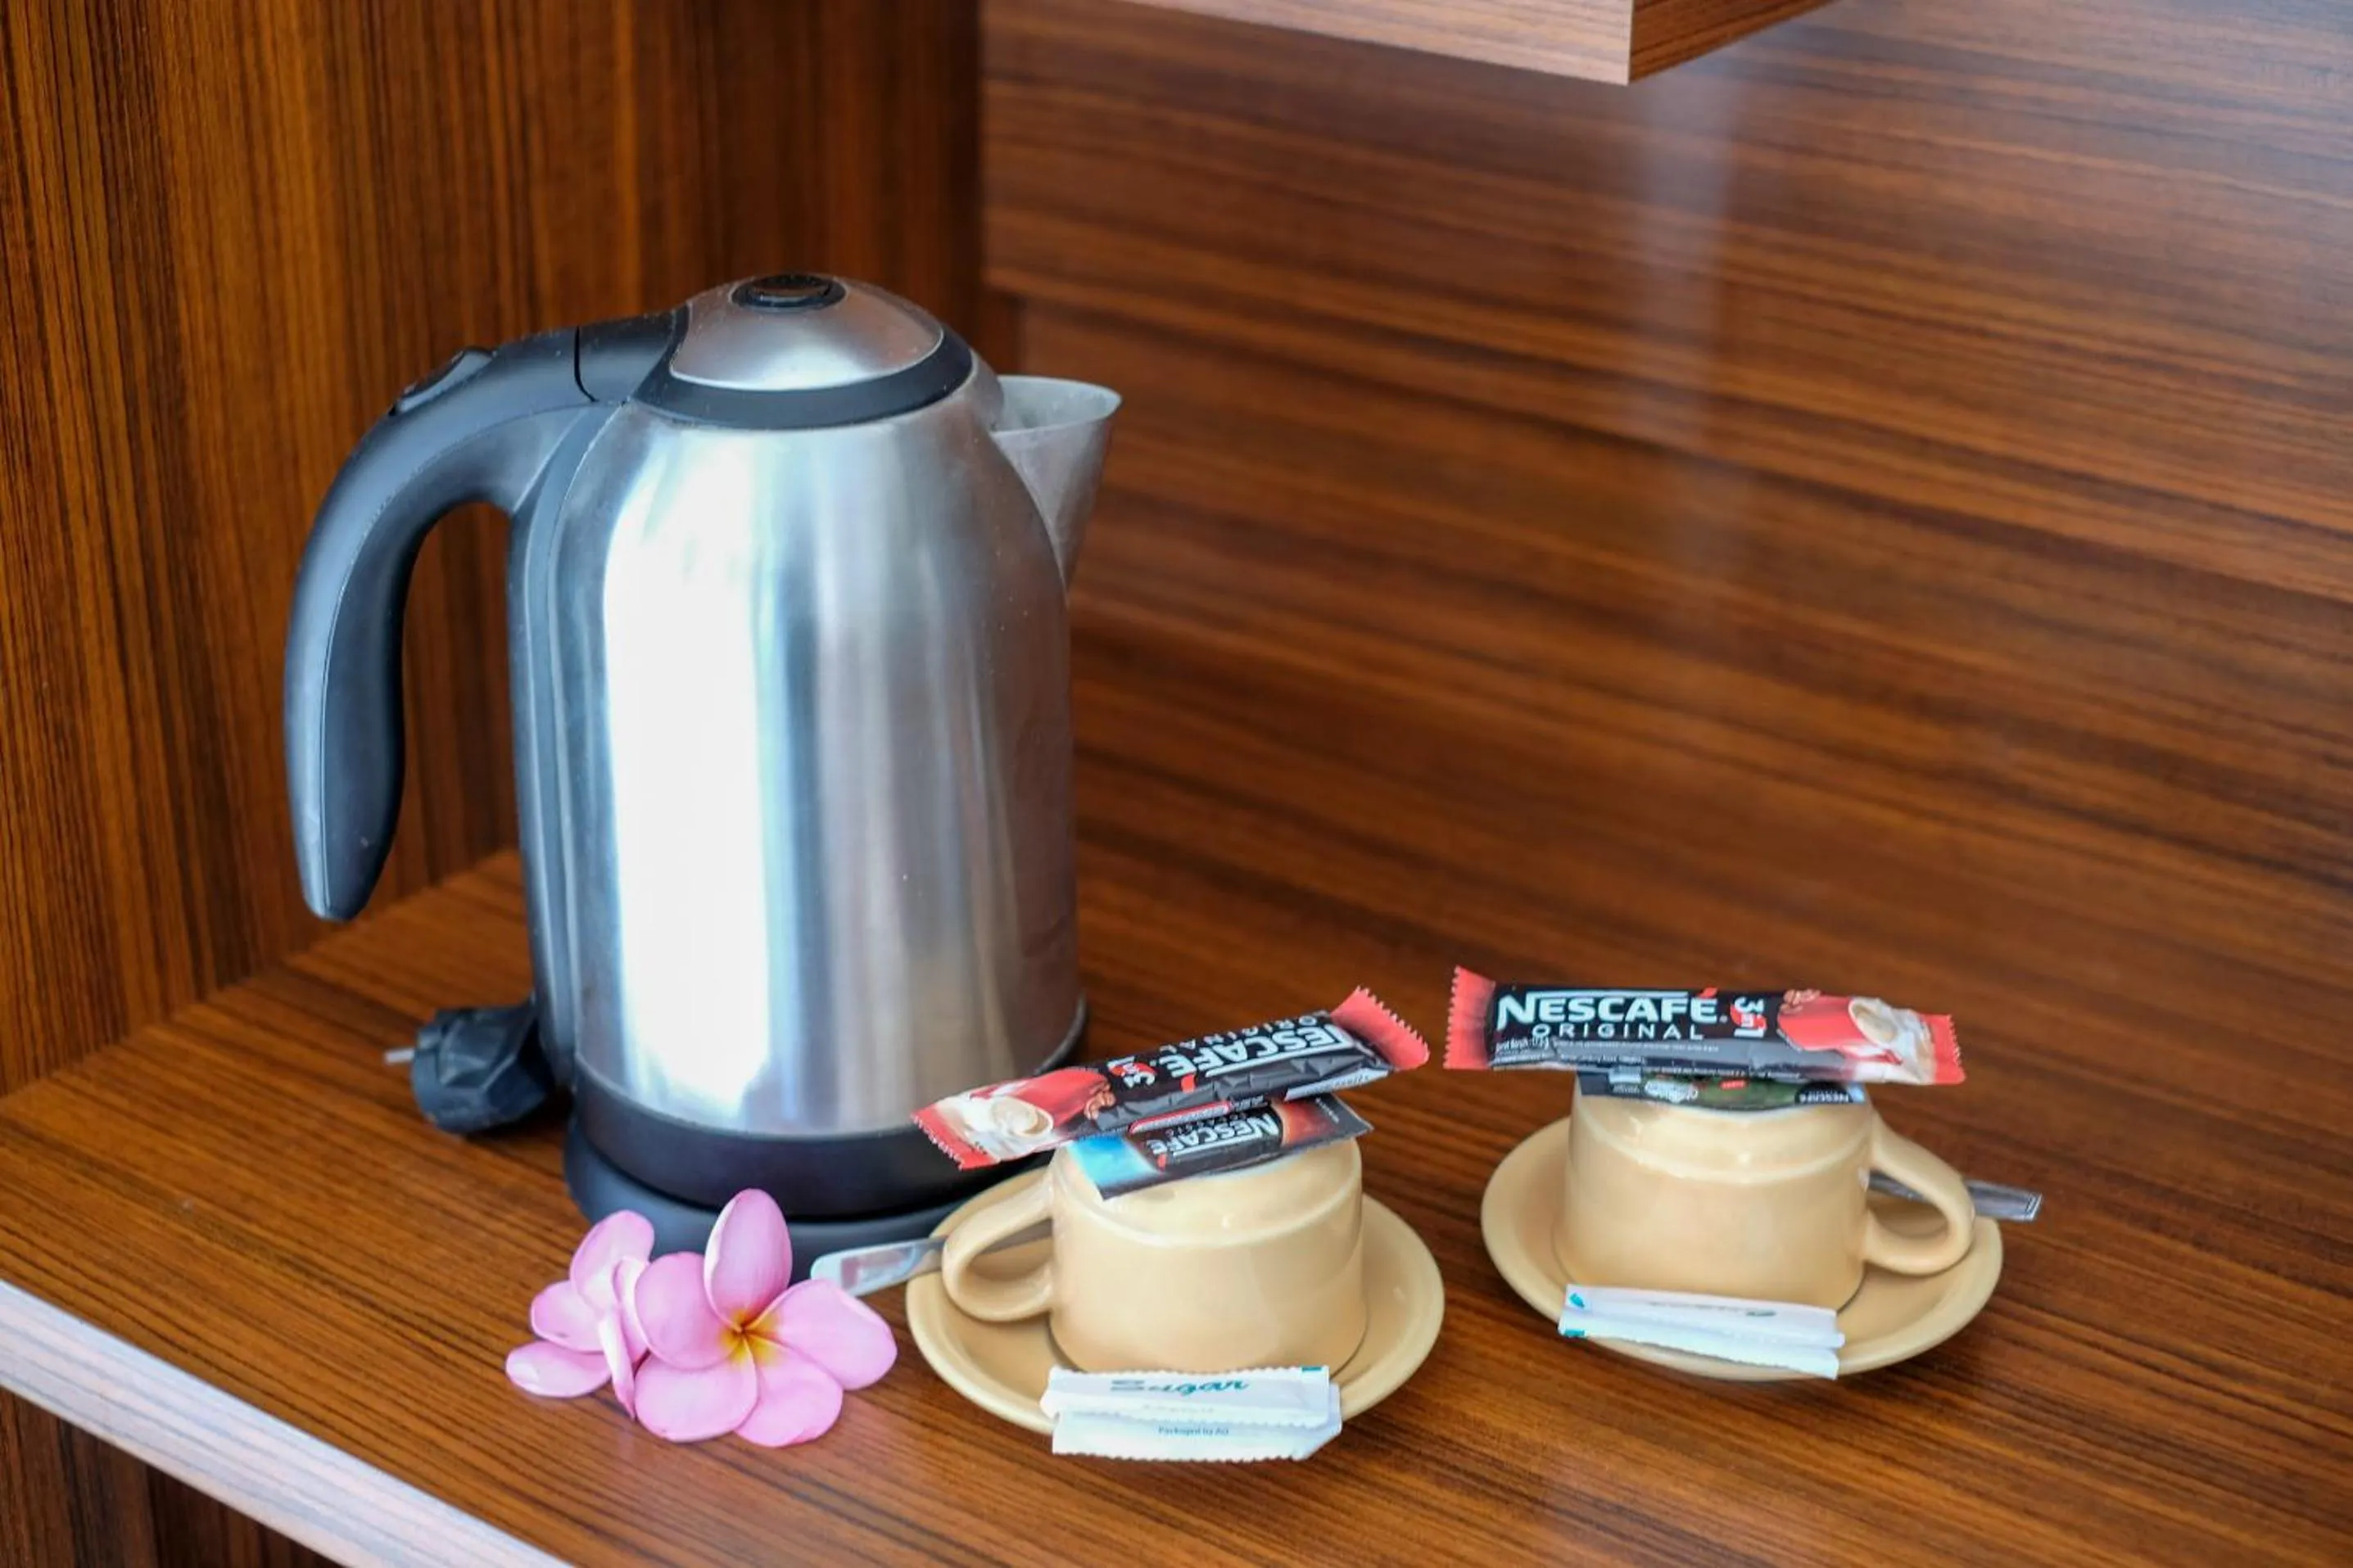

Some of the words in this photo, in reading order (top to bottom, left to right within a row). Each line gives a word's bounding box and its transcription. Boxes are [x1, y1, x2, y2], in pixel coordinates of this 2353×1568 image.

[1496, 987, 1718, 1032] NESCAFÉ
[1531, 1023, 1704, 1041] ORIGINAL
[1147, 1112, 1279, 1169] NESCAFÉ
